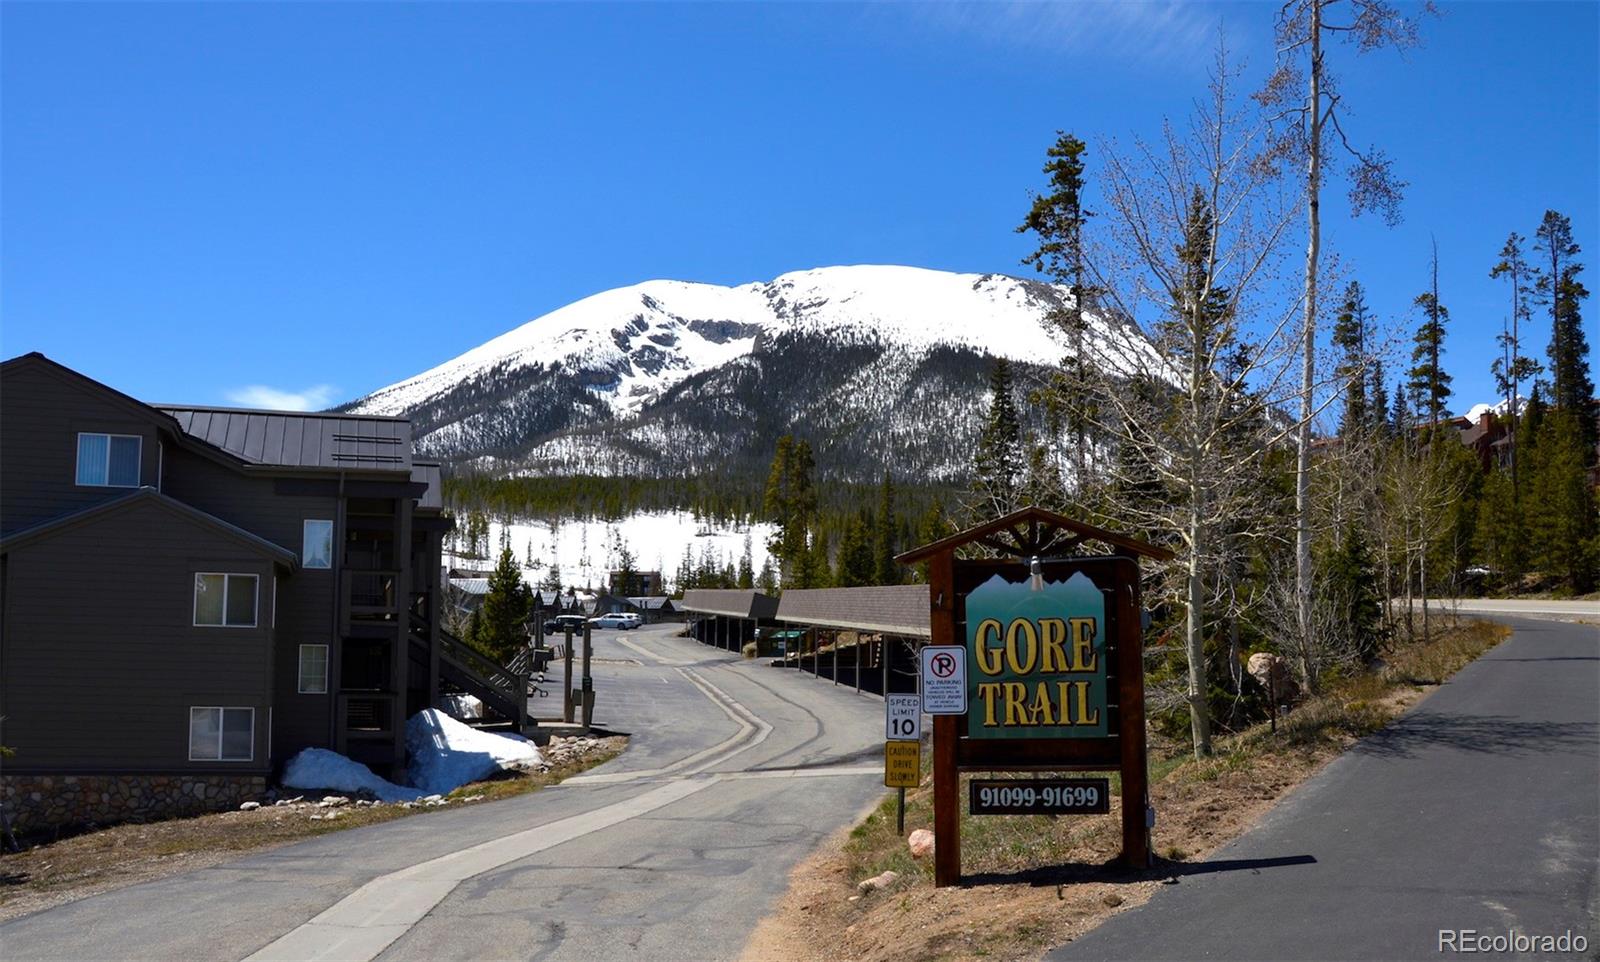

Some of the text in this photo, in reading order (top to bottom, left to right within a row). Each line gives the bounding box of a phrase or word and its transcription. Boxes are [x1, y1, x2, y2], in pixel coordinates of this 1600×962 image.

[975, 617, 1098, 675] GORE
[890, 698, 919, 706] SPEED
[978, 681, 1099, 727] TRAIL
[892, 719, 915, 735] 10
[889, 747, 917, 756] CAUTION
[893, 760, 912, 769] DRIVE
[890, 772, 915, 781] SLOWLY
[980, 787, 1098, 807] 91099-91699
